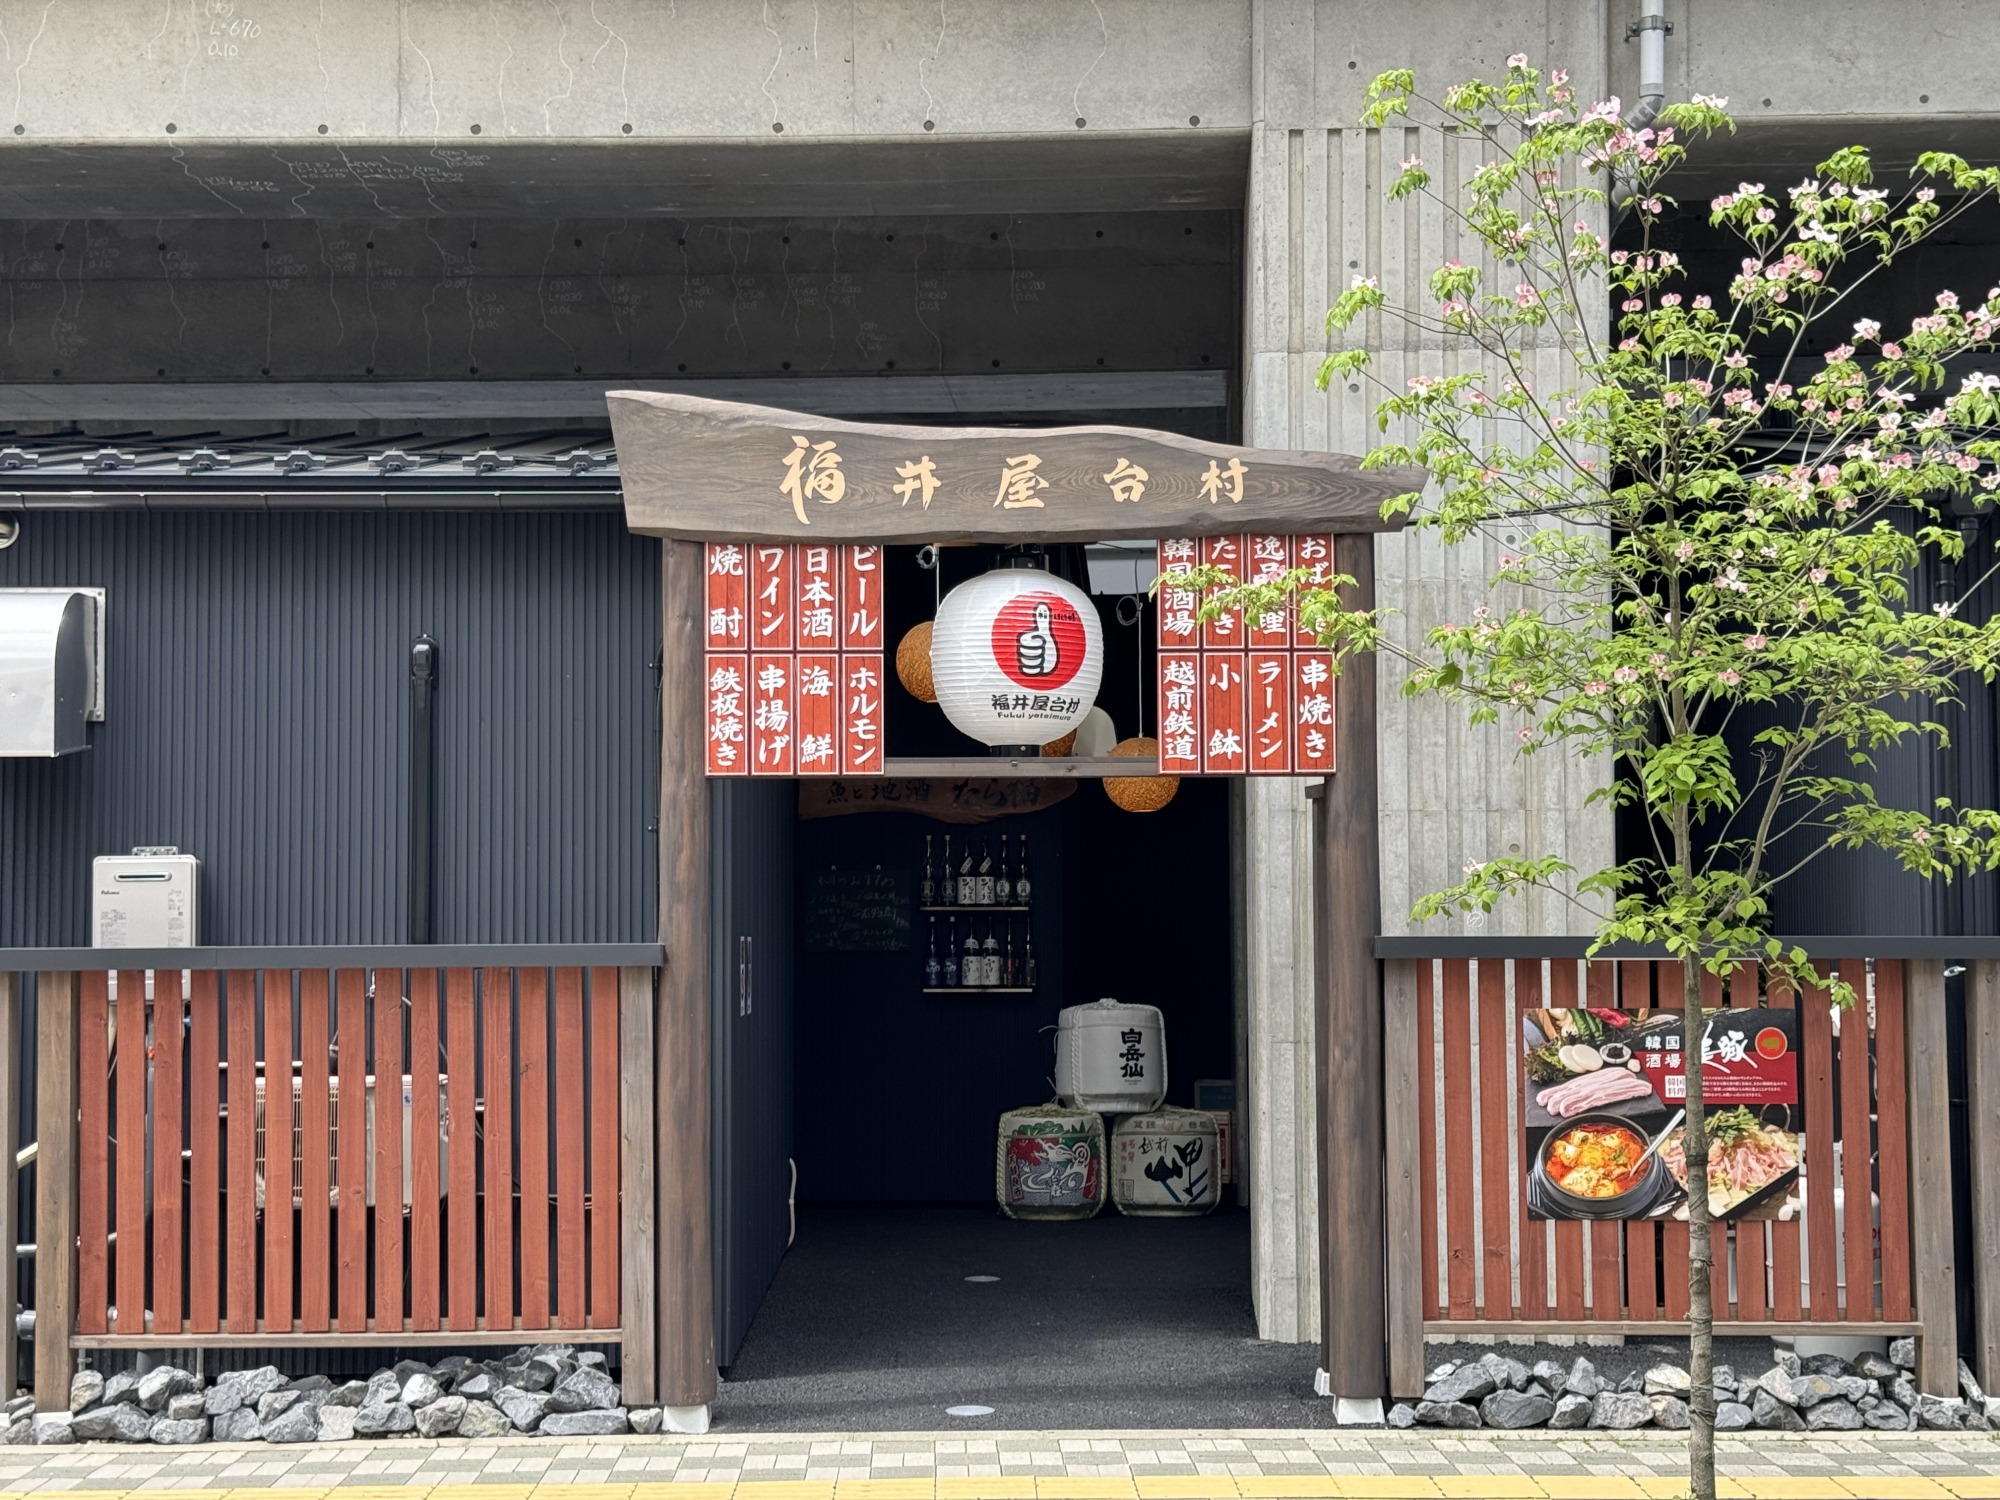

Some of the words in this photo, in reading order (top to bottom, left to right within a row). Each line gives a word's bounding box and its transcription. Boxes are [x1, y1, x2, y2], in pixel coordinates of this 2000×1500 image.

[208, 41, 239, 57] 0.10
[209, 20, 262, 39] L=670
[779, 434, 1249, 525] 福井屋台村
[709, 544, 744, 639] 焼酎
[758, 547, 785, 637] ワイン
[800, 547, 835, 639] 日本酒
[849, 545, 879, 638] ビール
[1253, 535, 1287, 635] 逸品理
[709, 666, 744, 767] 鉄板焼き
[754, 663, 790, 766] 串揚げ
[800, 664, 835, 767] 海鮮
[848, 667, 879, 766] ホルモン
[991, 693, 1081, 714] 福井屋台村
[997, 711, 1026, 719] Fukui
[1027, 712, 1072, 721] yataimura
[1162, 659, 1198, 761] 越前鉄道
[1208, 662, 1243, 760] 小鉢
[1255, 661, 1284, 759] ラーメン
[1298, 658, 1333, 759] 串焼き
[1119, 1027, 1146, 1078] 白岳仙
[1644, 1035, 1681, 1051] 韓国
[1645, 1053, 1682, 1069] 酒場
